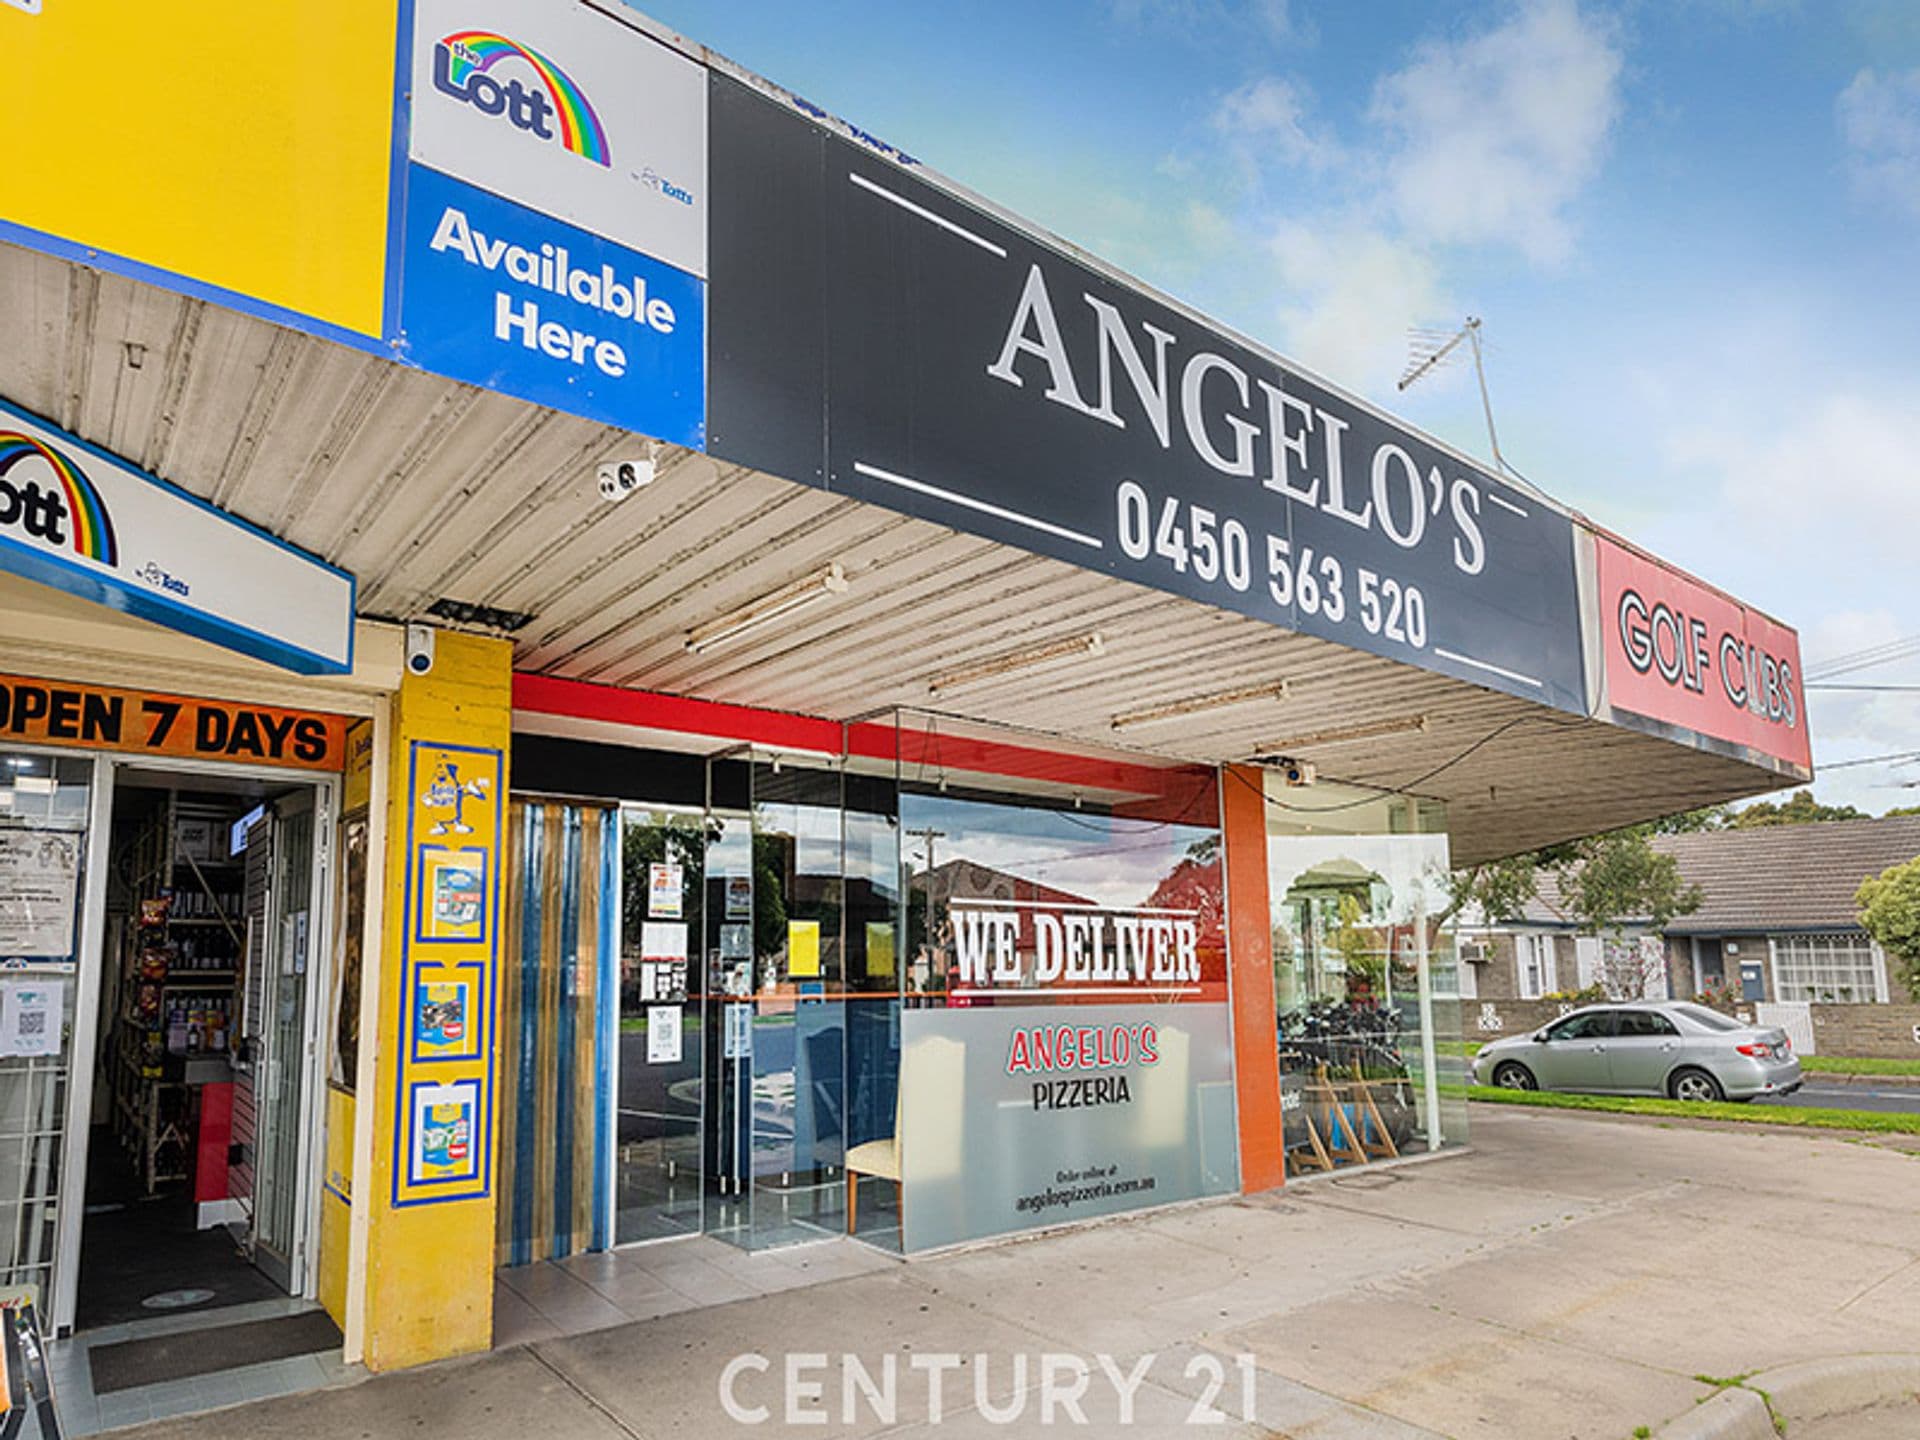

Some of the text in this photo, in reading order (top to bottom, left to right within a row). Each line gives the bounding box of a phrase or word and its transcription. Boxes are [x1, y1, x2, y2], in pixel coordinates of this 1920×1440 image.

[433, 42, 554, 141] Lott
[429, 206, 677, 334] Available
[494, 291, 627, 378] Here
[986, 262, 1486, 577] ANGELO'S
[1116, 479, 1428, 650] 0450 563 520
[1617, 587, 1797, 730] GOLF CLUBS
[141, 698, 184, 748] 7
[194, 705, 328, 763] DAYS
[950, 909, 1202, 984] WE DELIVER
[1006, 1023, 1161, 1074] ANGELO'S
[1031, 1075, 1133, 1111] PIZZERIA
